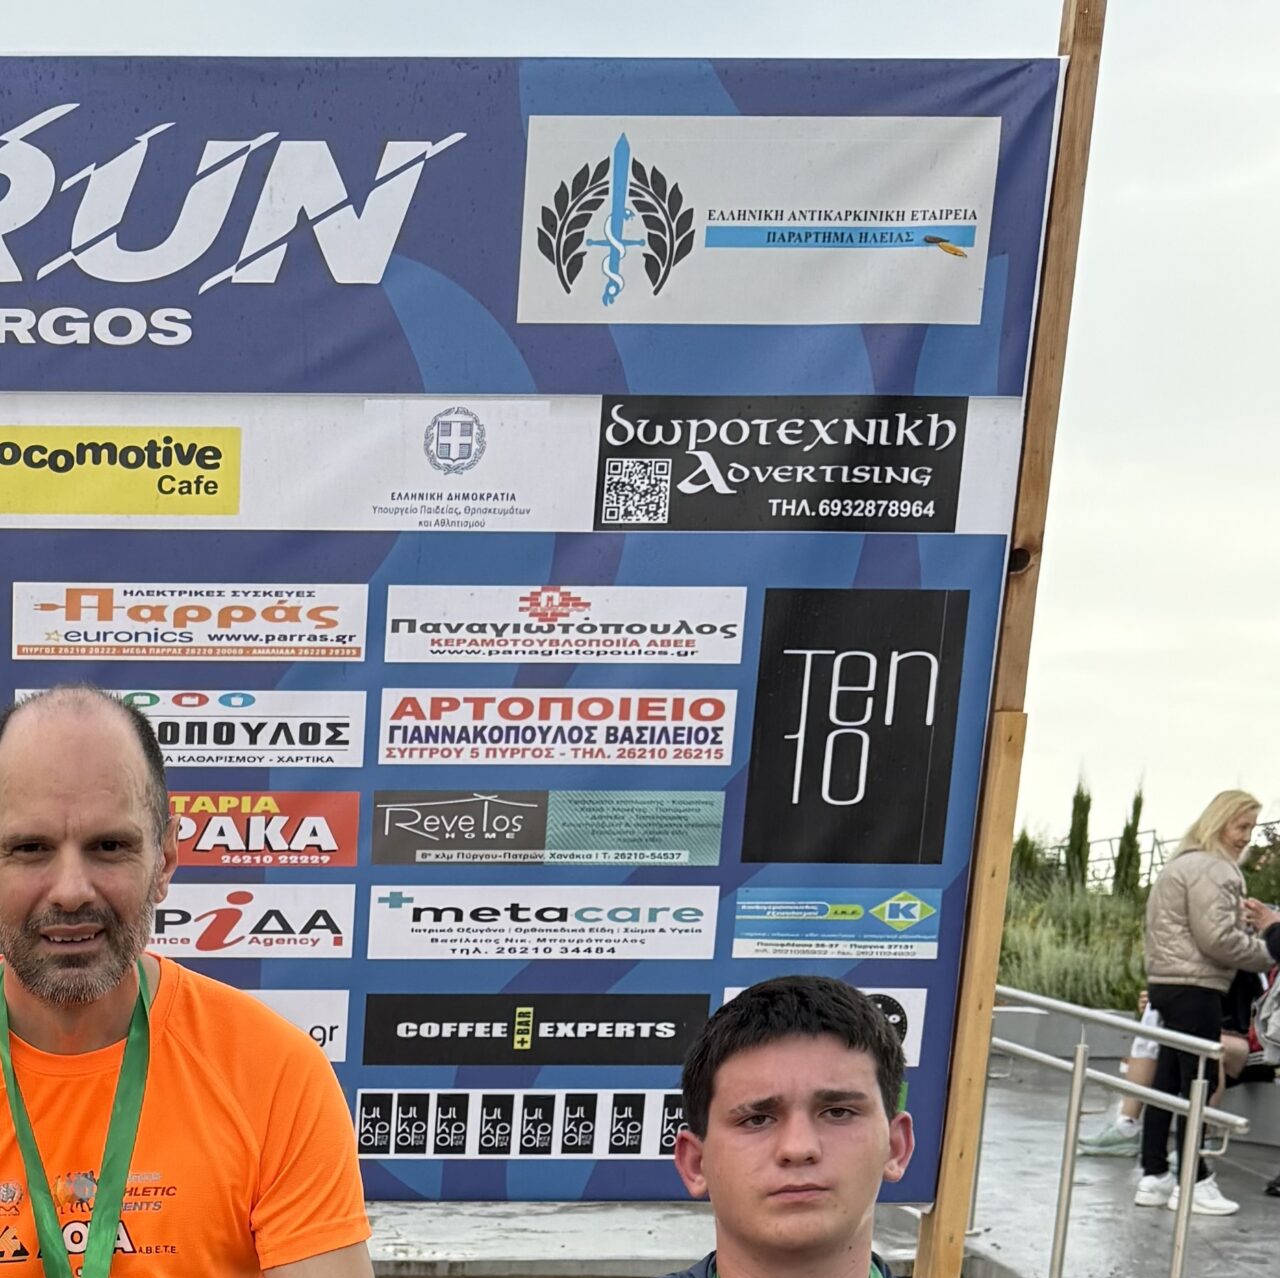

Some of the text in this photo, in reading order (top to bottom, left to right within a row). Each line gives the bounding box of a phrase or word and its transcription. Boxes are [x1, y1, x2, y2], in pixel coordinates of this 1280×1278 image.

[707, 207, 978, 224] ΕΛΛΗΝΙΚΗ ΑΝΤΙΚΑΡΚΙΝΙΚΗ ΕΤΑΙΡΕΙΑ
[766, 229, 915, 245] ΠΑΡΑΡΤΗΜΑ ΗΛΕΙΑΣ
[157, 474, 218, 496] Cafe
[391, 492, 516, 501] ΕΛΛΗΝΙΚΗ ΔΗΜΟΚΡΑΤΙΑ
[123, 589, 316, 598] ΗΛΕΚΤΡΙΚΕΣ ΣΥΣΚΕΥΕΣ
[65, 588, 340, 629] Παρράς
[64, 628, 357, 645] euronics www.parras.gr
[391, 617, 738, 639] Παναγιωτόπουλος
[390, 697, 726, 721] ΑΡΤΟΠΟΙΕΙΟ
[158, 721, 350, 745] ΟΠΟΥΛΟΣ
[389, 726, 723, 744] ΓΙΑΝΝΑΚΟΠΟΥΛΟΣ ΒΑΣΙΛΕΙΟΣ
[178, 755, 334, 764] ΚΑΘΑΡΙΣΜΟΥ ΧΑΡΤΙΚΑ
[386, 748, 724, 759] ΣΥΓΓΡΟΥ 5 ΠΥΡΓΟΣ ΤΗΛ. 26210 26215
[170, 796, 280, 813] ΤΑΡΙΑ
[175, 814, 340, 852] ΡΑΚΑ
[445, 832, 516, 840] HOME
[221, 855, 331, 865] 26210 22229
[412, 903, 705, 923] metacare
[248, 936, 320, 947] Agency
[396, 1022, 508, 1039] COFFEE
[538, 1022, 676, 1039] EXPERTS
[125, 1186, 177, 1197] HLETIC
